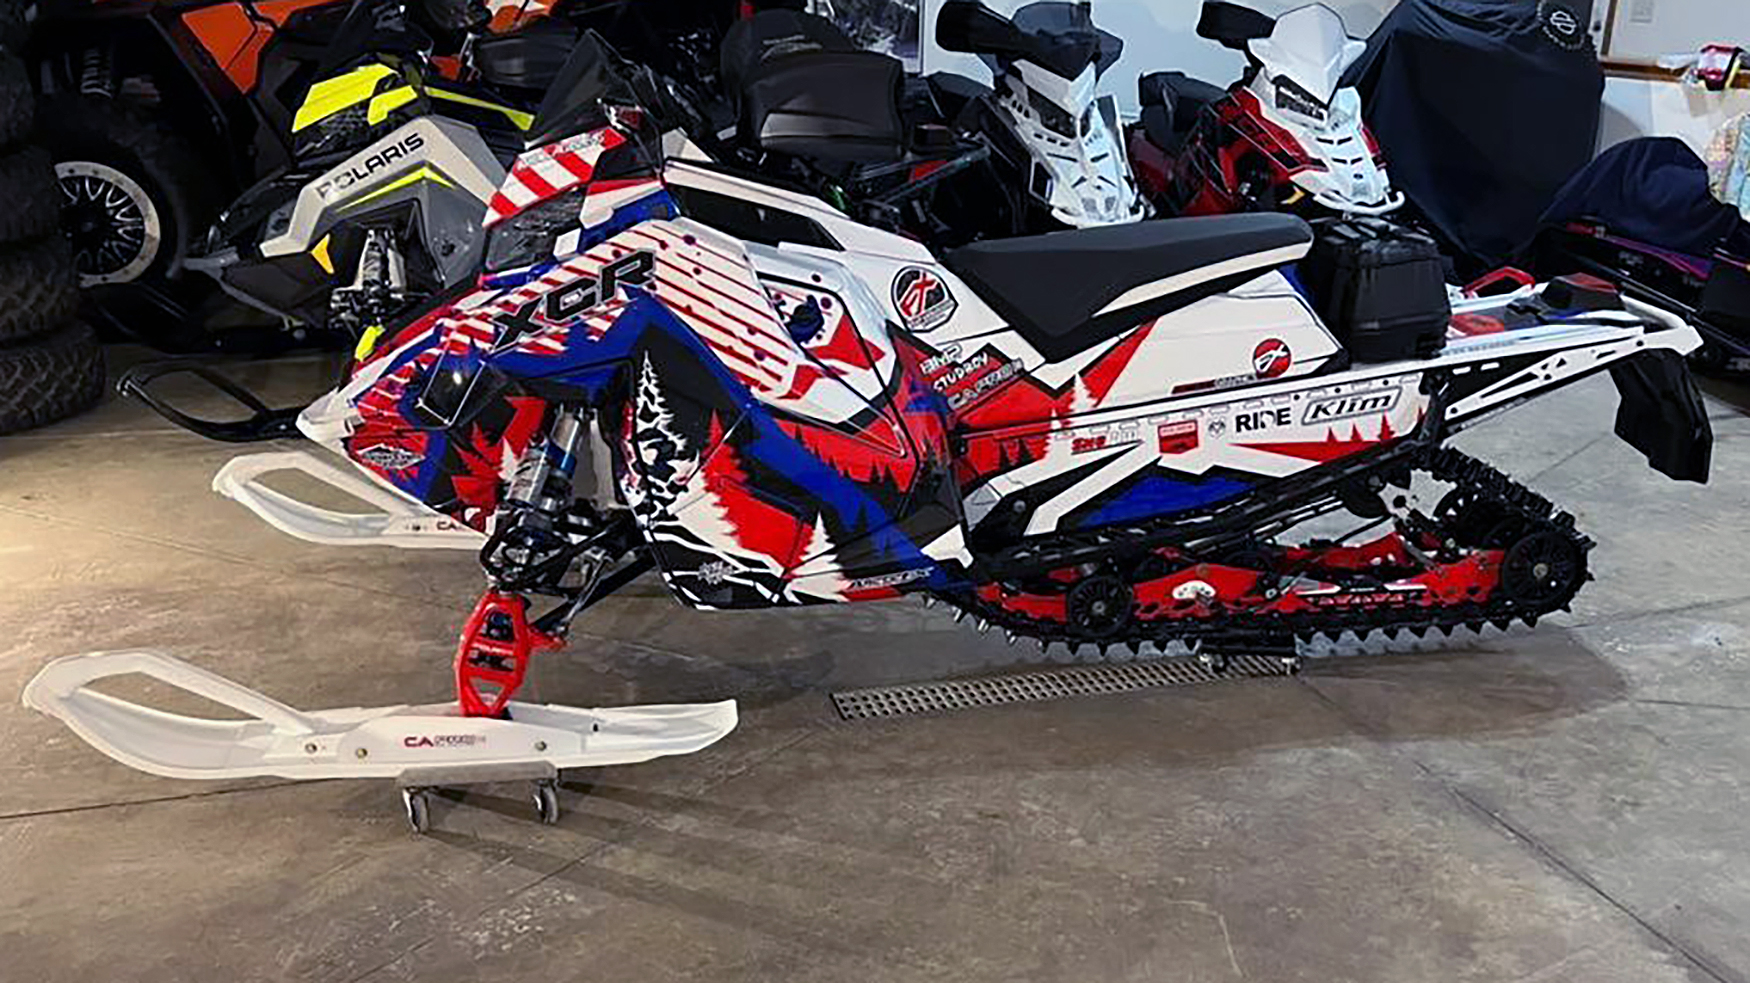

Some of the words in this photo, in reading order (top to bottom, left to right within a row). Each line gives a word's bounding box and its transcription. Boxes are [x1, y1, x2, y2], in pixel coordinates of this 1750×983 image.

[315, 132, 425, 200] POLARIS
[487, 247, 658, 356] XCR
[404, 736, 434, 747] CA
